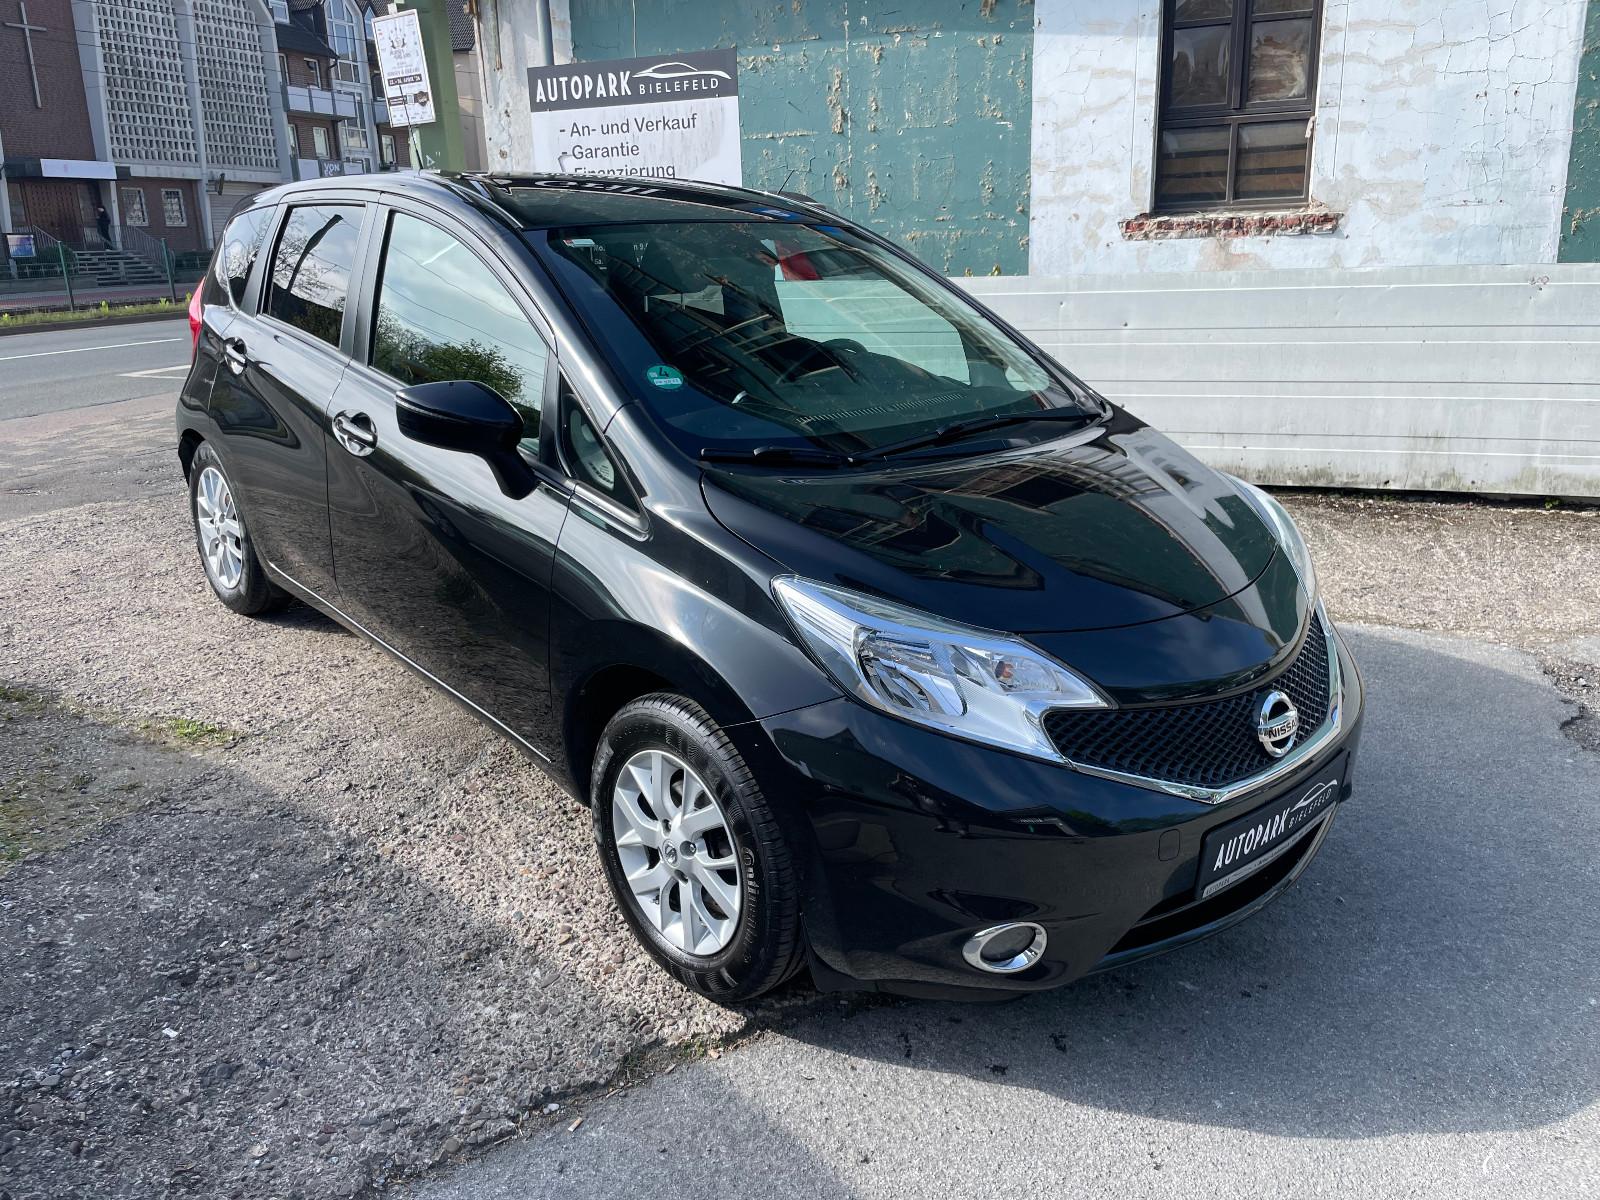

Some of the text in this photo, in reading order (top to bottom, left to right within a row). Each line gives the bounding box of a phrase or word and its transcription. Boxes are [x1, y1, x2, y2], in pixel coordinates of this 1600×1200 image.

[535, 70, 719, 103] AUTOPARK BIELEFELD
[570, 122, 596, 137] An-
[601, 119, 630, 135] und
[634, 113, 698, 132] Verkauf
[572, 142, 640, 160] Garantie
[574, 164, 676, 179] nzierung
[1213, 807, 1290, 871] AUTOPARK
